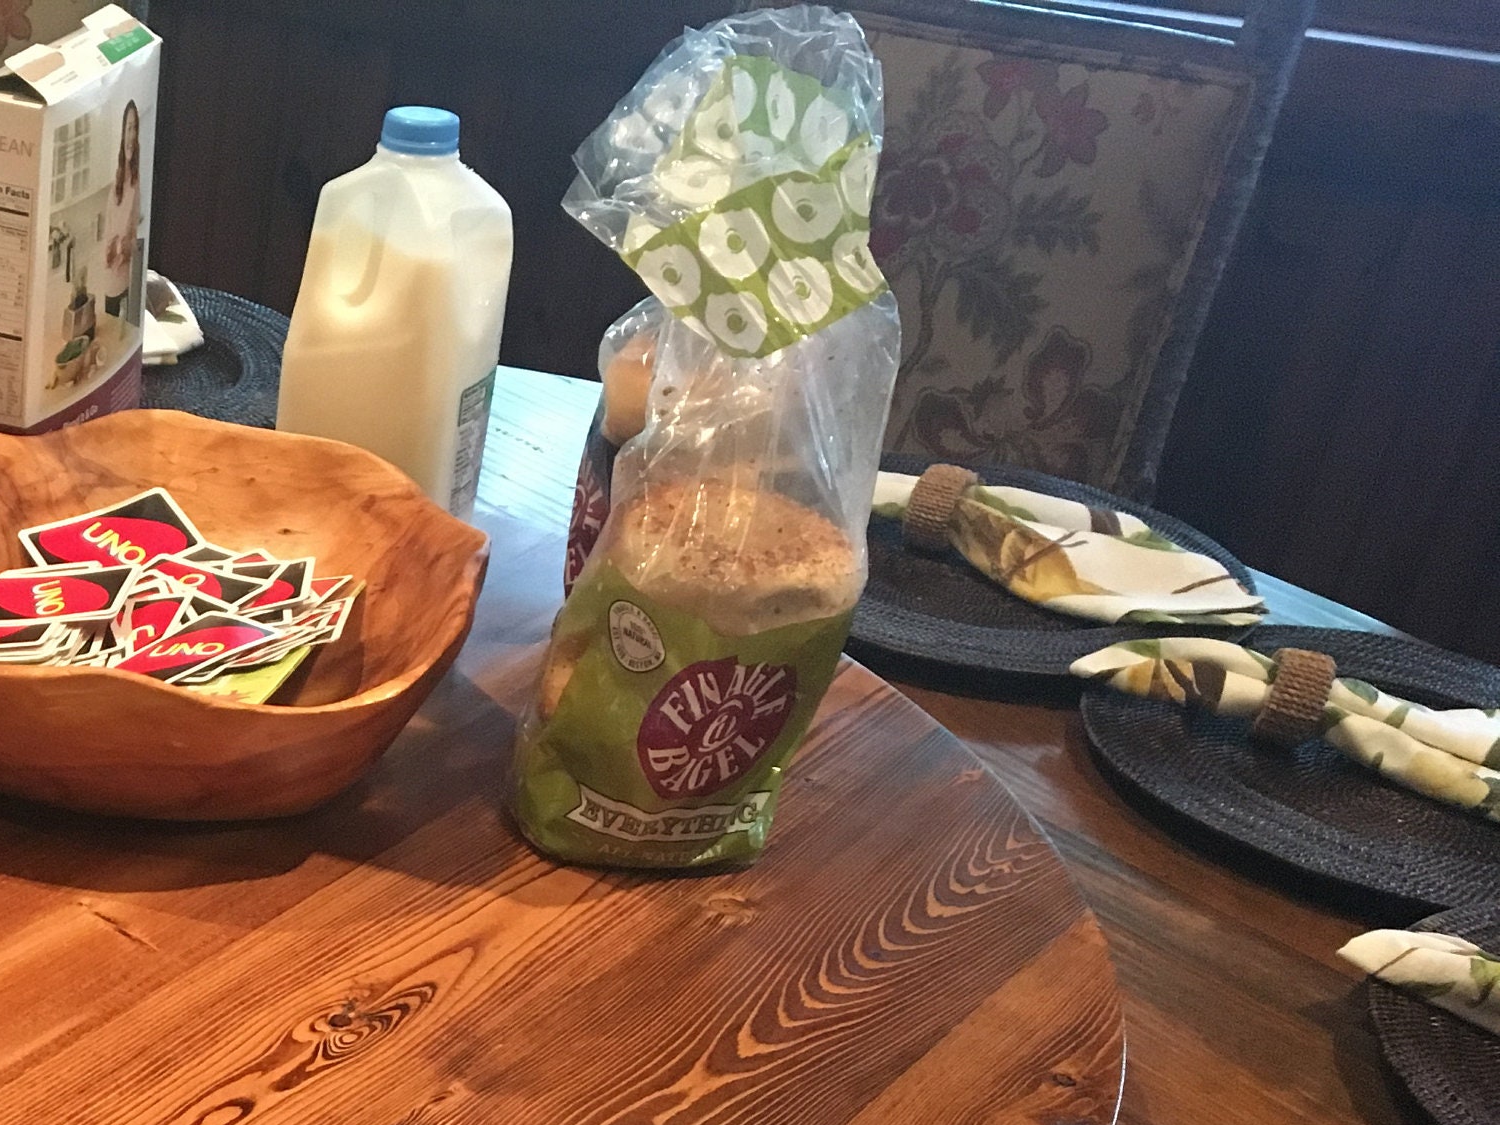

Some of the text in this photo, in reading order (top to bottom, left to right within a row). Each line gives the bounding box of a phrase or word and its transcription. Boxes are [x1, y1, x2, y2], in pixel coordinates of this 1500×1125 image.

[5, 187, 30, 200] Facts
[81, 522, 146, 565] UNO
[32, 580, 65, 615] UNO
[148, 642, 225, 656] UNO
[660, 661, 787, 735] FINAGLE
[647, 735, 765, 792] BAGEL
[581, 797, 757, 836] EVERYTHING
